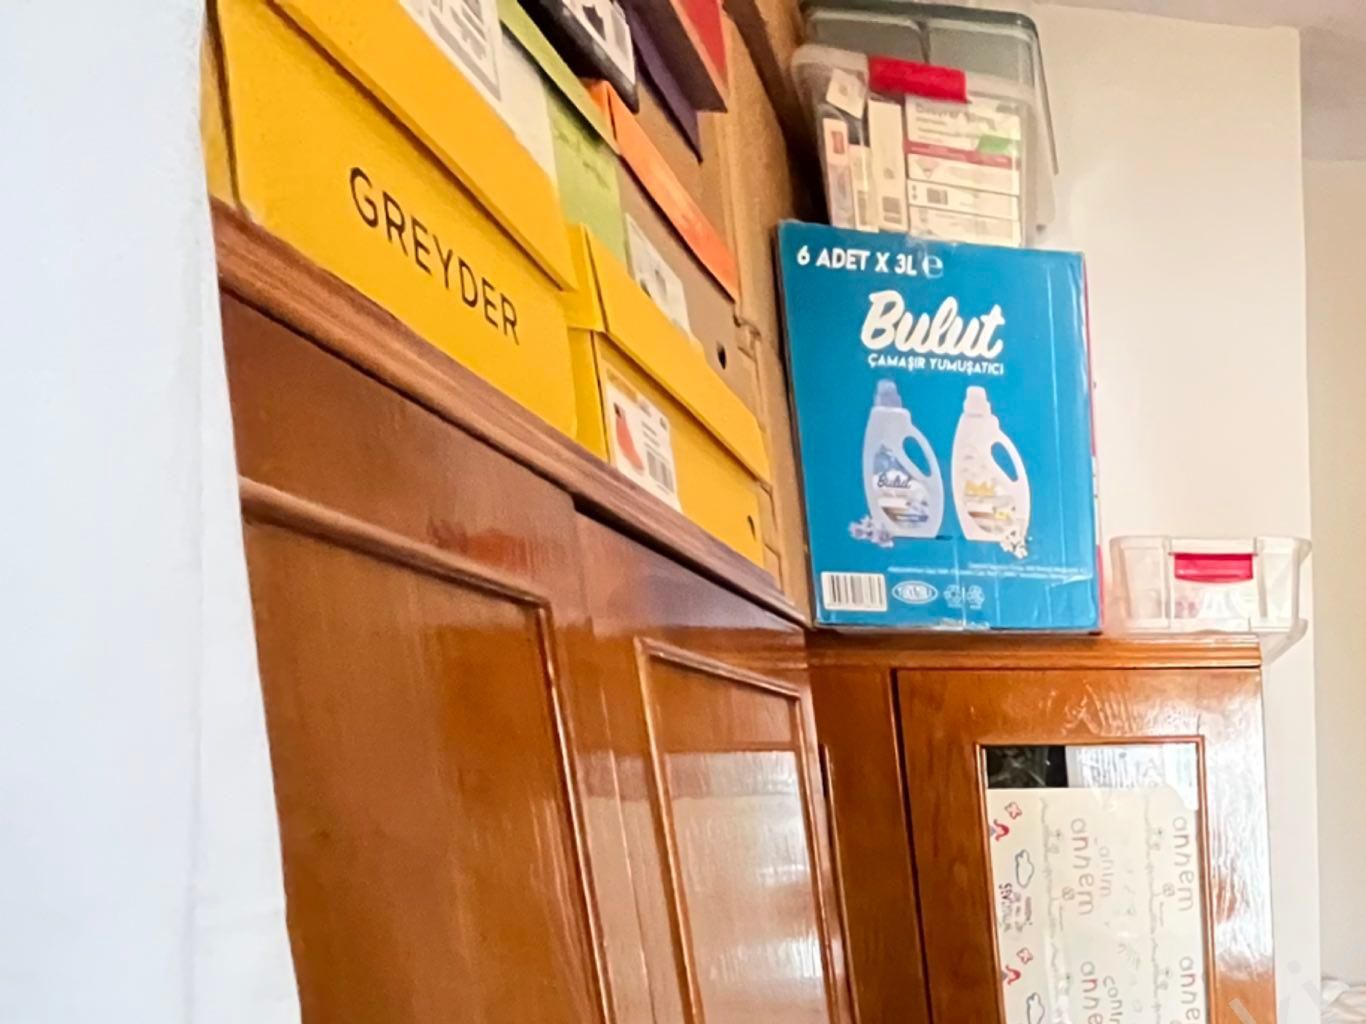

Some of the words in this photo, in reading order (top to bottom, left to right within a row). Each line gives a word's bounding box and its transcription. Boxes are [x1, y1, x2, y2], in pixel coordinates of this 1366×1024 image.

[349, 166, 520, 346] GREYDER
[797, 245, 809, 266] 6
[816, 248, 870, 271] ADET
[875, 252, 890, 273] X
[895, 253, 917, 276] 3L
[861, 290, 1006, 359] Bulut
[868, 353, 925, 372] ÇAMAŞIR
[930, 358, 1005, 376] YUMUŞATICI
